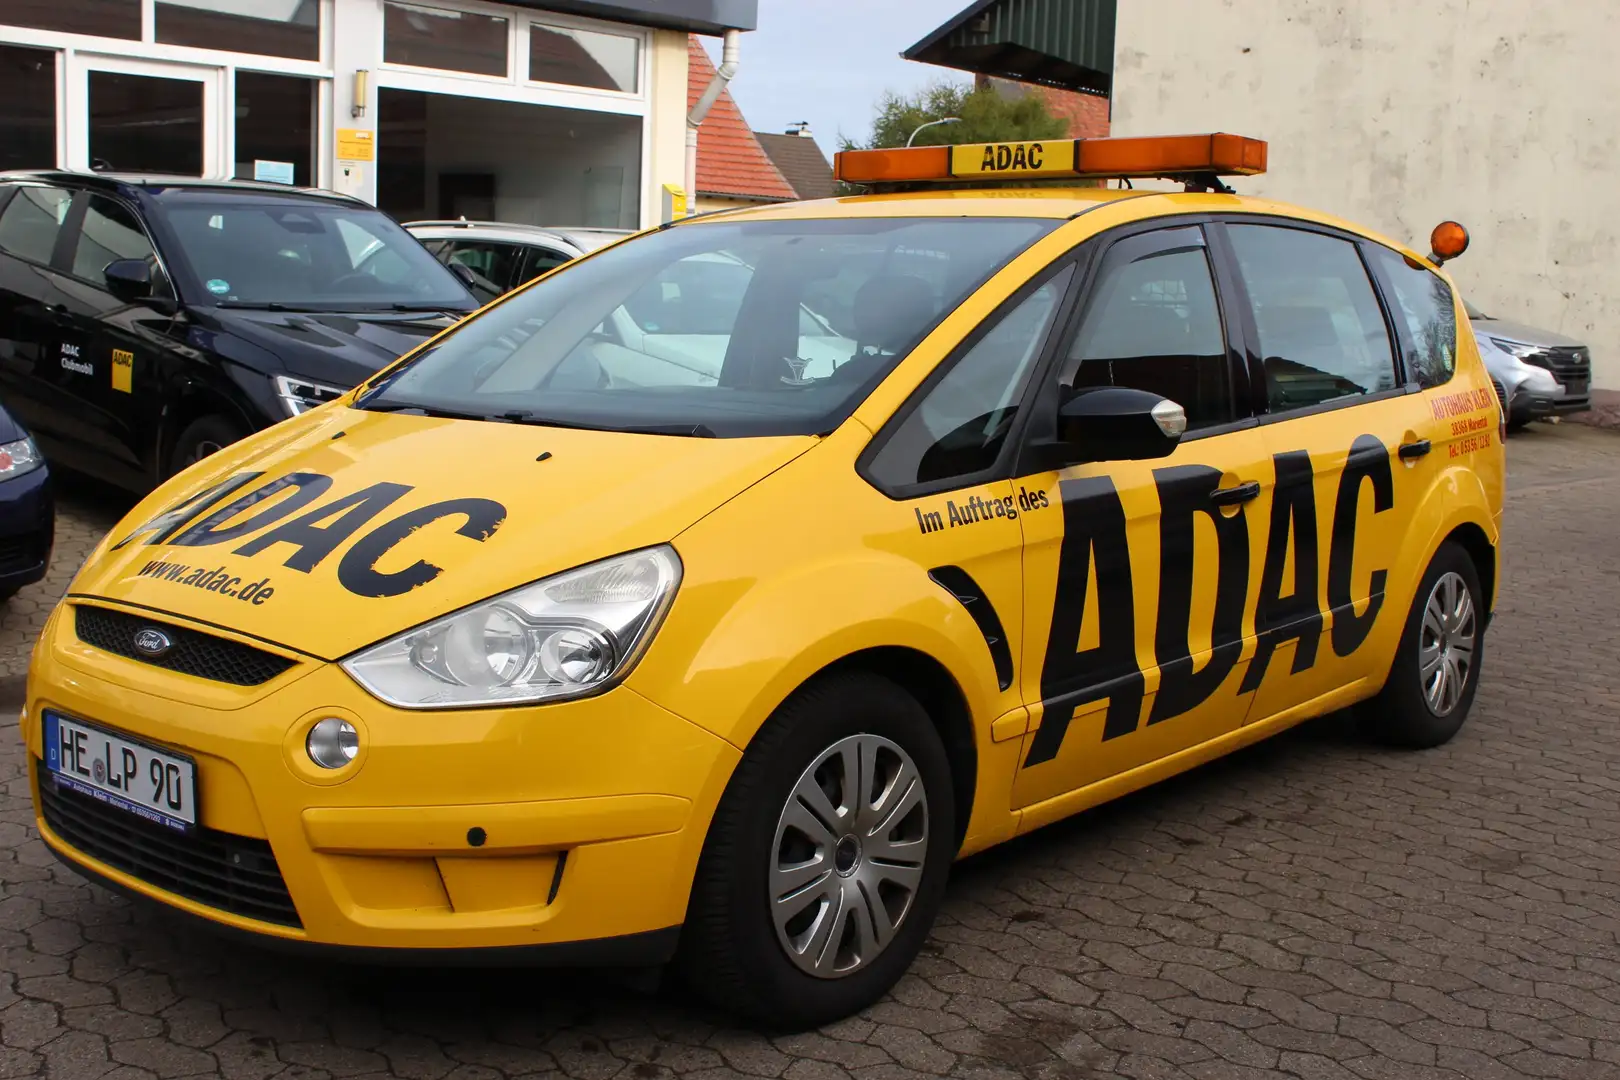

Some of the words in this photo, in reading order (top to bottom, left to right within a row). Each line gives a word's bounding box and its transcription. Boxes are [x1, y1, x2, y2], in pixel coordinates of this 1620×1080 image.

[981, 143, 1043, 171] ADAC
[61, 343, 80, 357] ADAC
[113, 350, 132, 368] ADAC
[1431, 391, 1474, 420] AUTOHAUS
[1470, 387, 1493, 410] KLEIN
[914, 507, 944, 534] Im
[946, 495, 1018, 528] Auftrag
[1018, 486, 1049, 512] des
[110, 472, 508, 598] ADAC
[137, 557, 275, 606] www.adac.de
[1022, 433, 1394, 769] ADAC
[139, 632, 161, 649] Ford
[60, 725, 91, 777] HE
[105, 741, 137, 792] LP
[150, 758, 182, 811] 90
